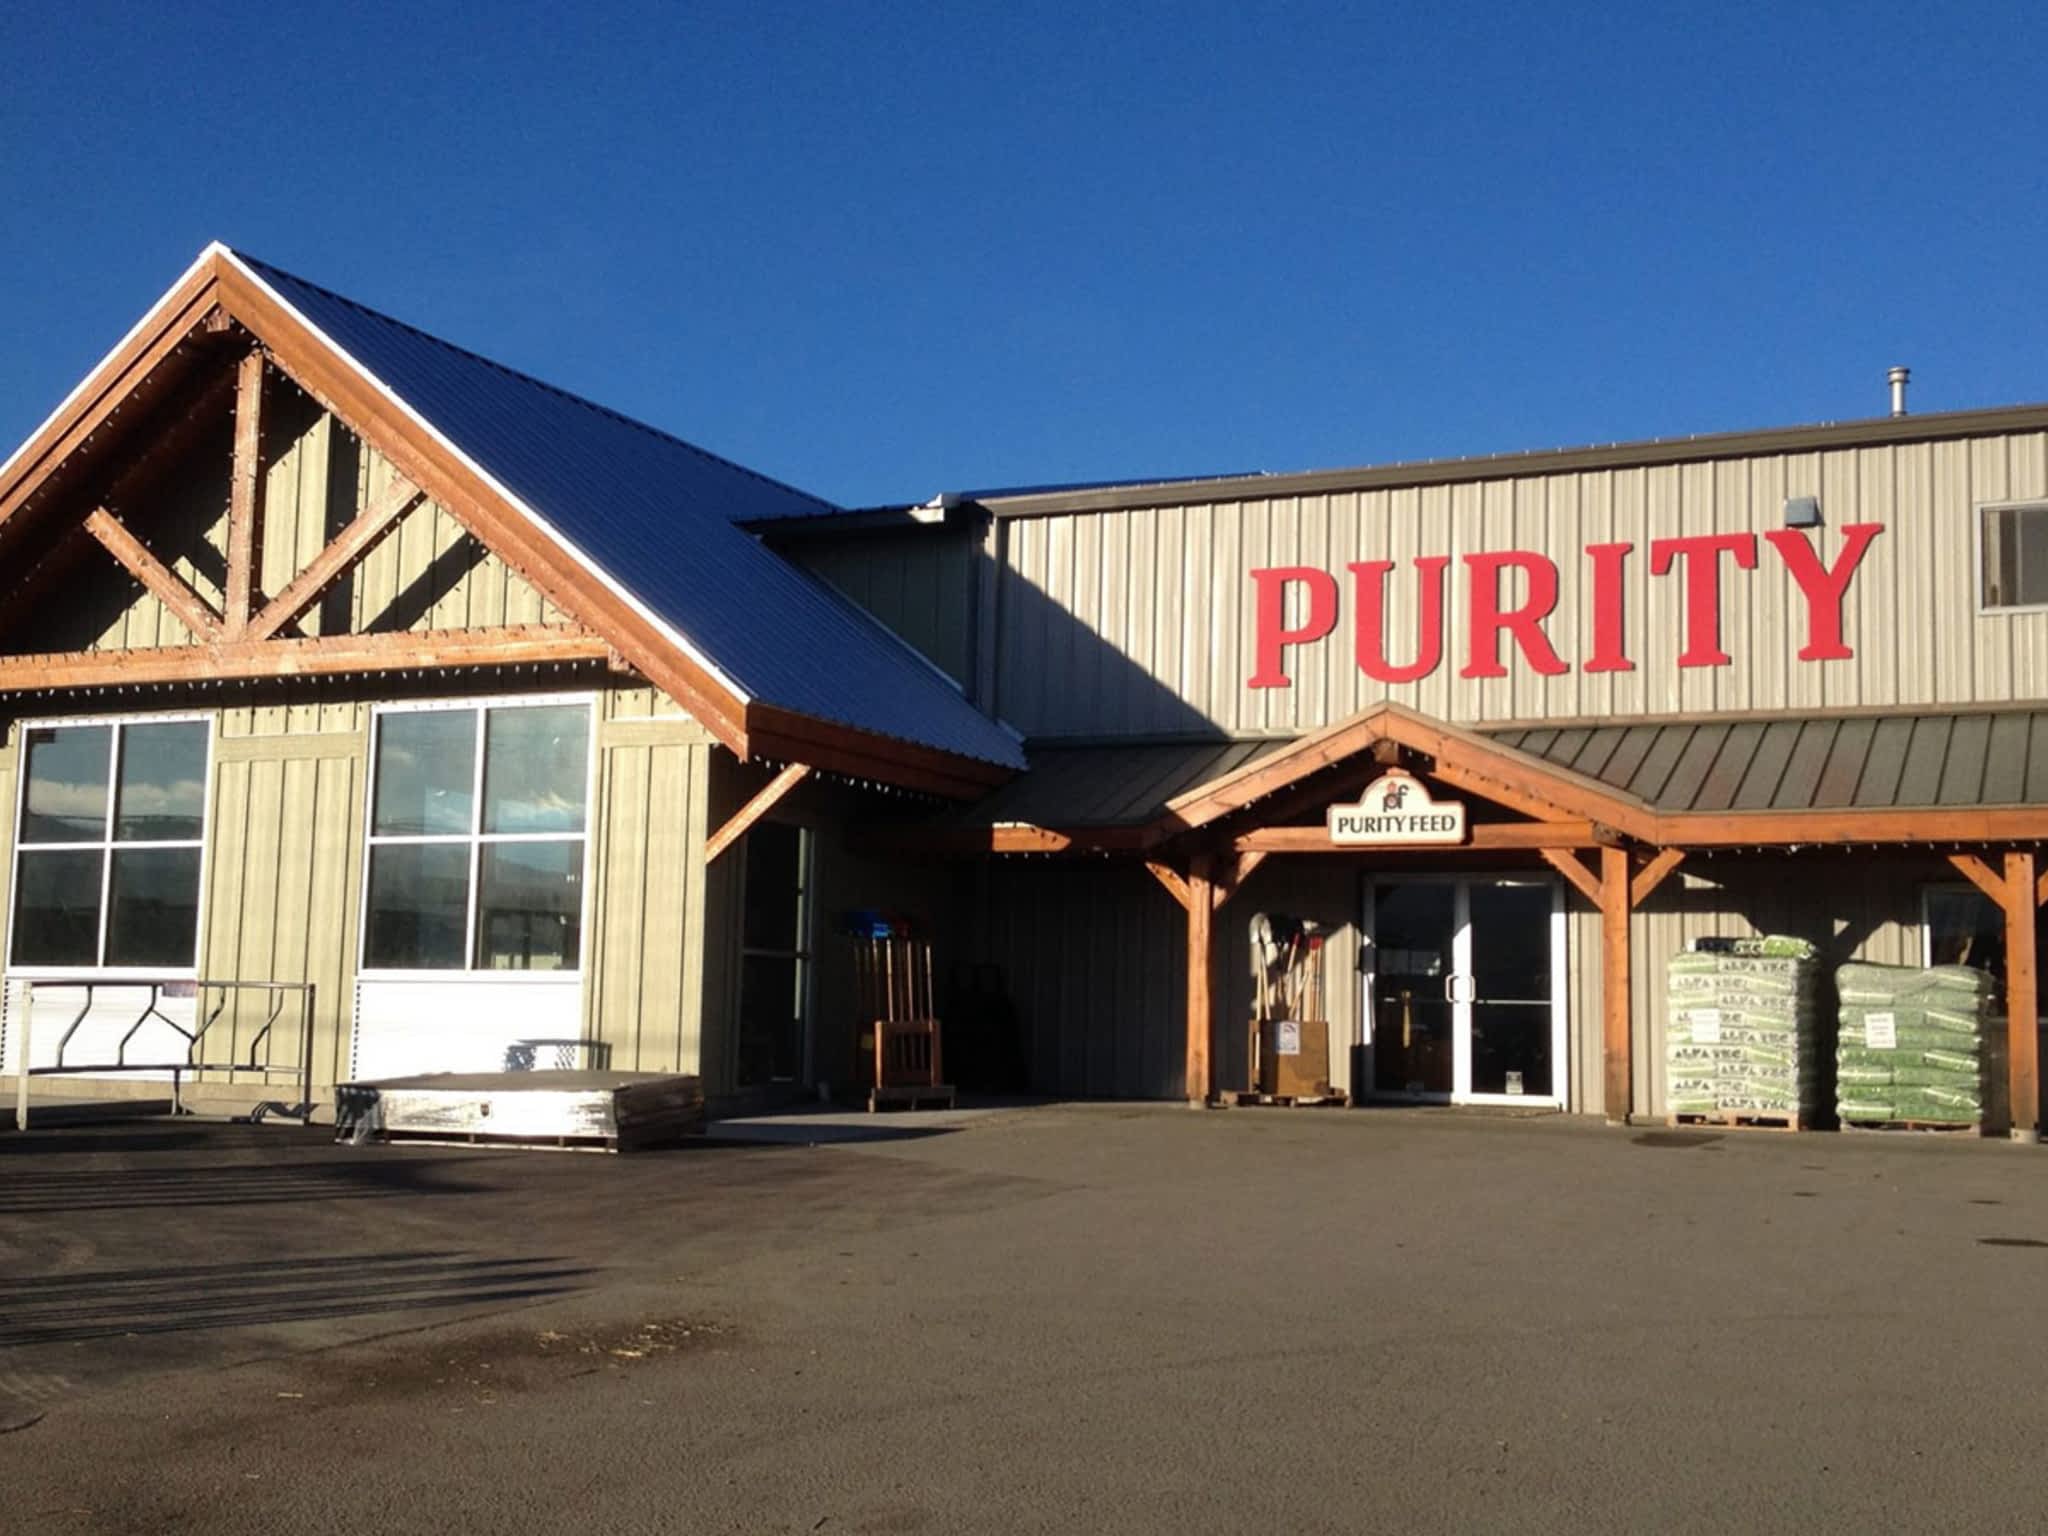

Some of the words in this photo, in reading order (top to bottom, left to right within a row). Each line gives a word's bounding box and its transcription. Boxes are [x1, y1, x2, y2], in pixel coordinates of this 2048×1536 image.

[1247, 523, 1885, 689] PURITY
[1338, 815, 1406, 833] PURITY
[1410, 815, 1456, 832] FEED
